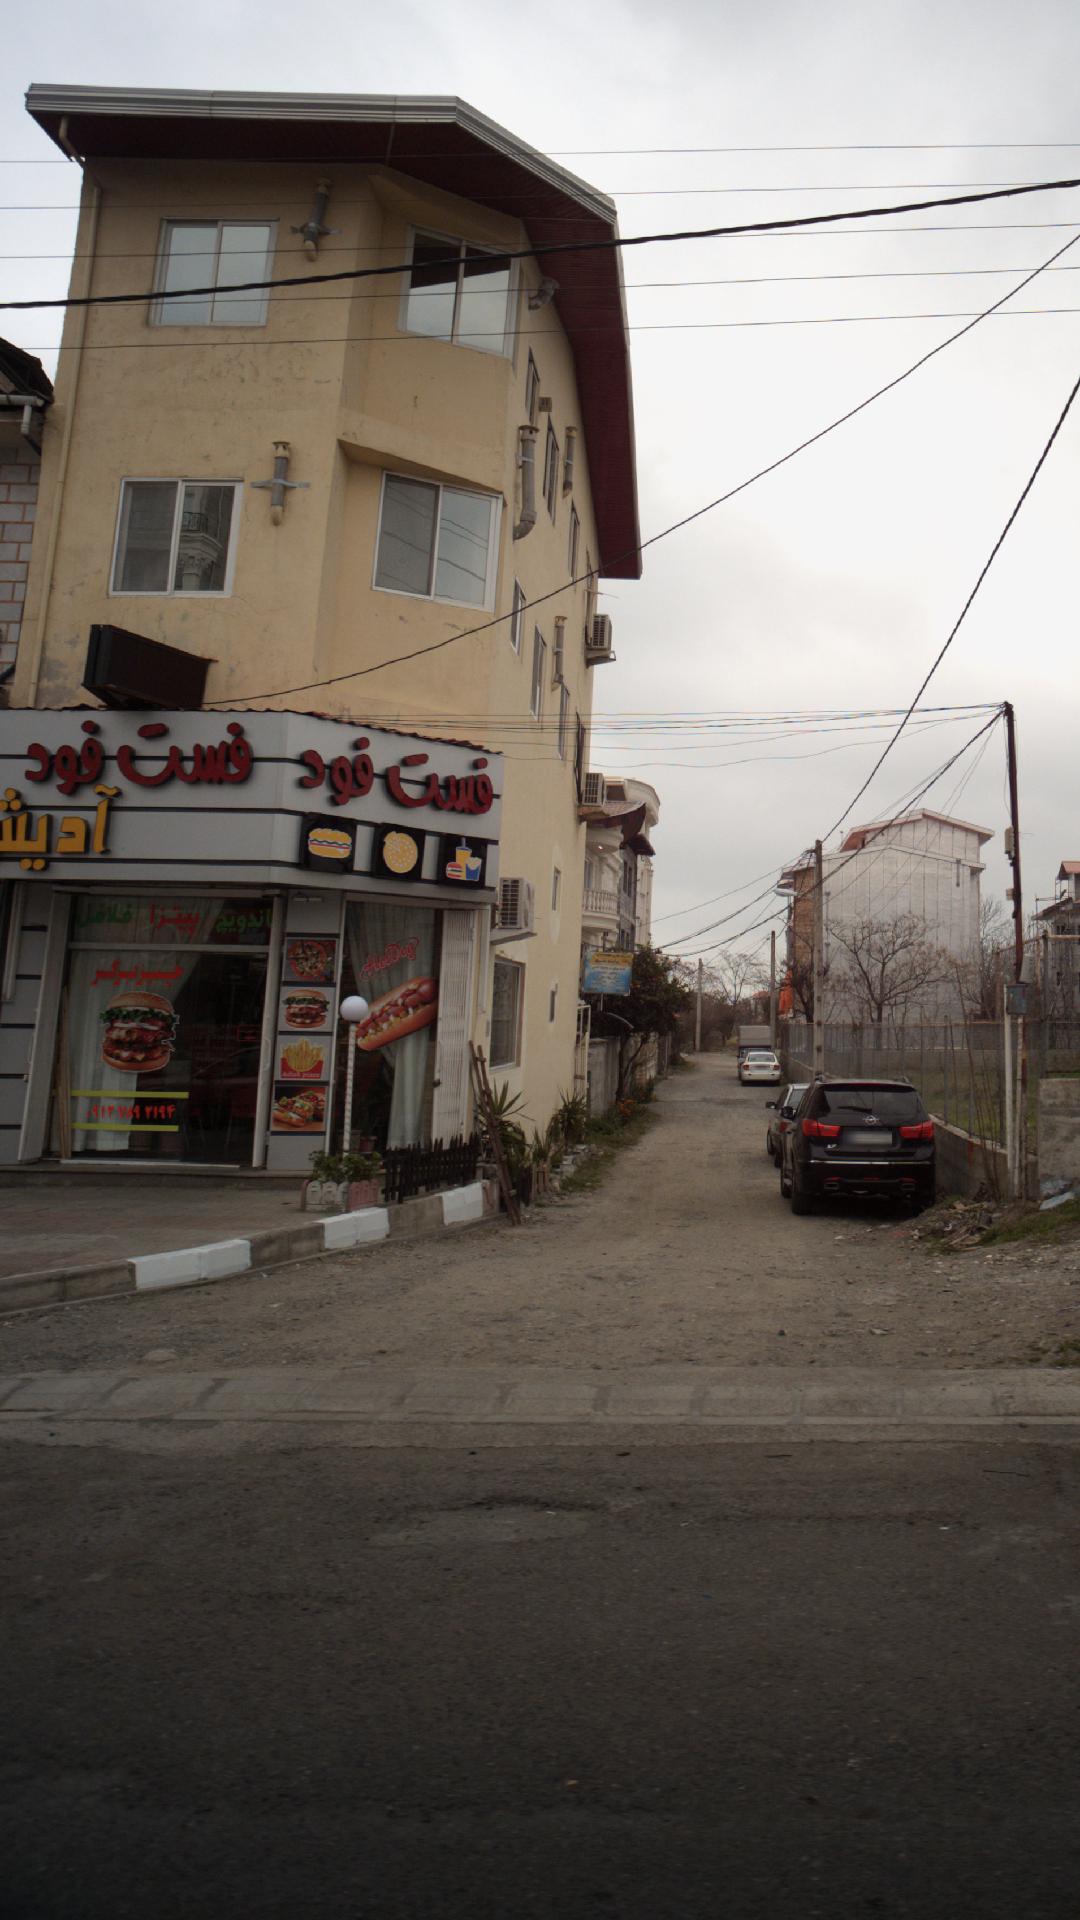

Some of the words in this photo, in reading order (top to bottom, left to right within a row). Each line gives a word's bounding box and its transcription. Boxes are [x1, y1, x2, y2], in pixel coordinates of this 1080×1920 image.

[25, 719, 104, 795] فود
[116, 721, 252, 786] فست
[300, 736, 374, 805] فود
[386, 757, 494, 815] فست
[148, 902, 201, 938] پیتزا
[214, 907, 272, 933] اندویچ
